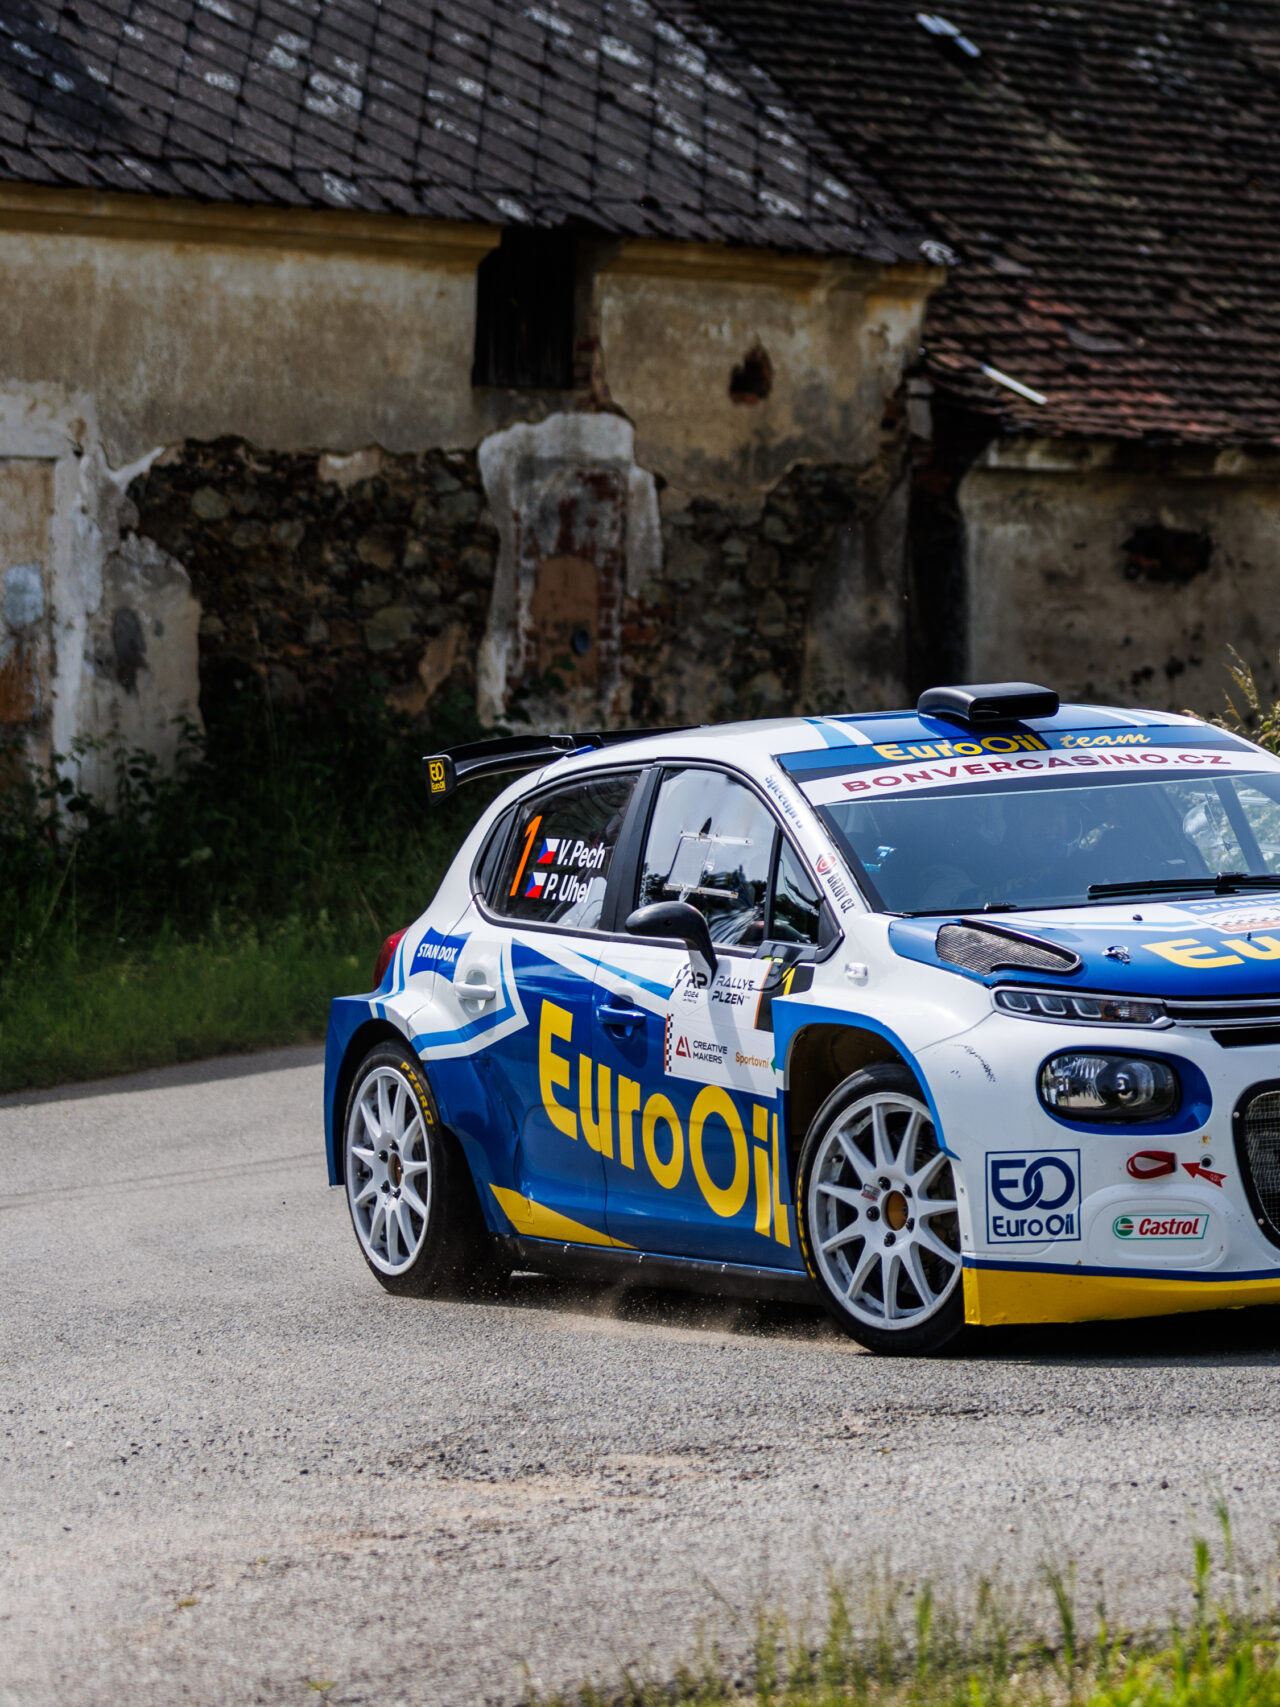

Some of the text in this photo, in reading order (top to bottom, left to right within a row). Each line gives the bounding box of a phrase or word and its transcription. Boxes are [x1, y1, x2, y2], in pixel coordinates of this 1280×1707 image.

[872, 733, 1150, 761] EuroOil team
[842, 754, 1231, 792] BONVERCASINO.CZ
[509, 815, 543, 896] 1
[557, 839, 606, 869] V.Pech
[417, 943, 458, 963] STANDOX
[711, 990, 745, 1006] PLZEŇ
[692, 1040, 728, 1055] CREATIVE
[692, 1051, 723, 1065] MAKERS
[735, 1051, 770, 1069] Sportovní
[539, 999, 791, 1248] EuroOil
[992, 1214, 1075, 1237] EuroOil
[1138, 1217, 1200, 1235] Castrol
